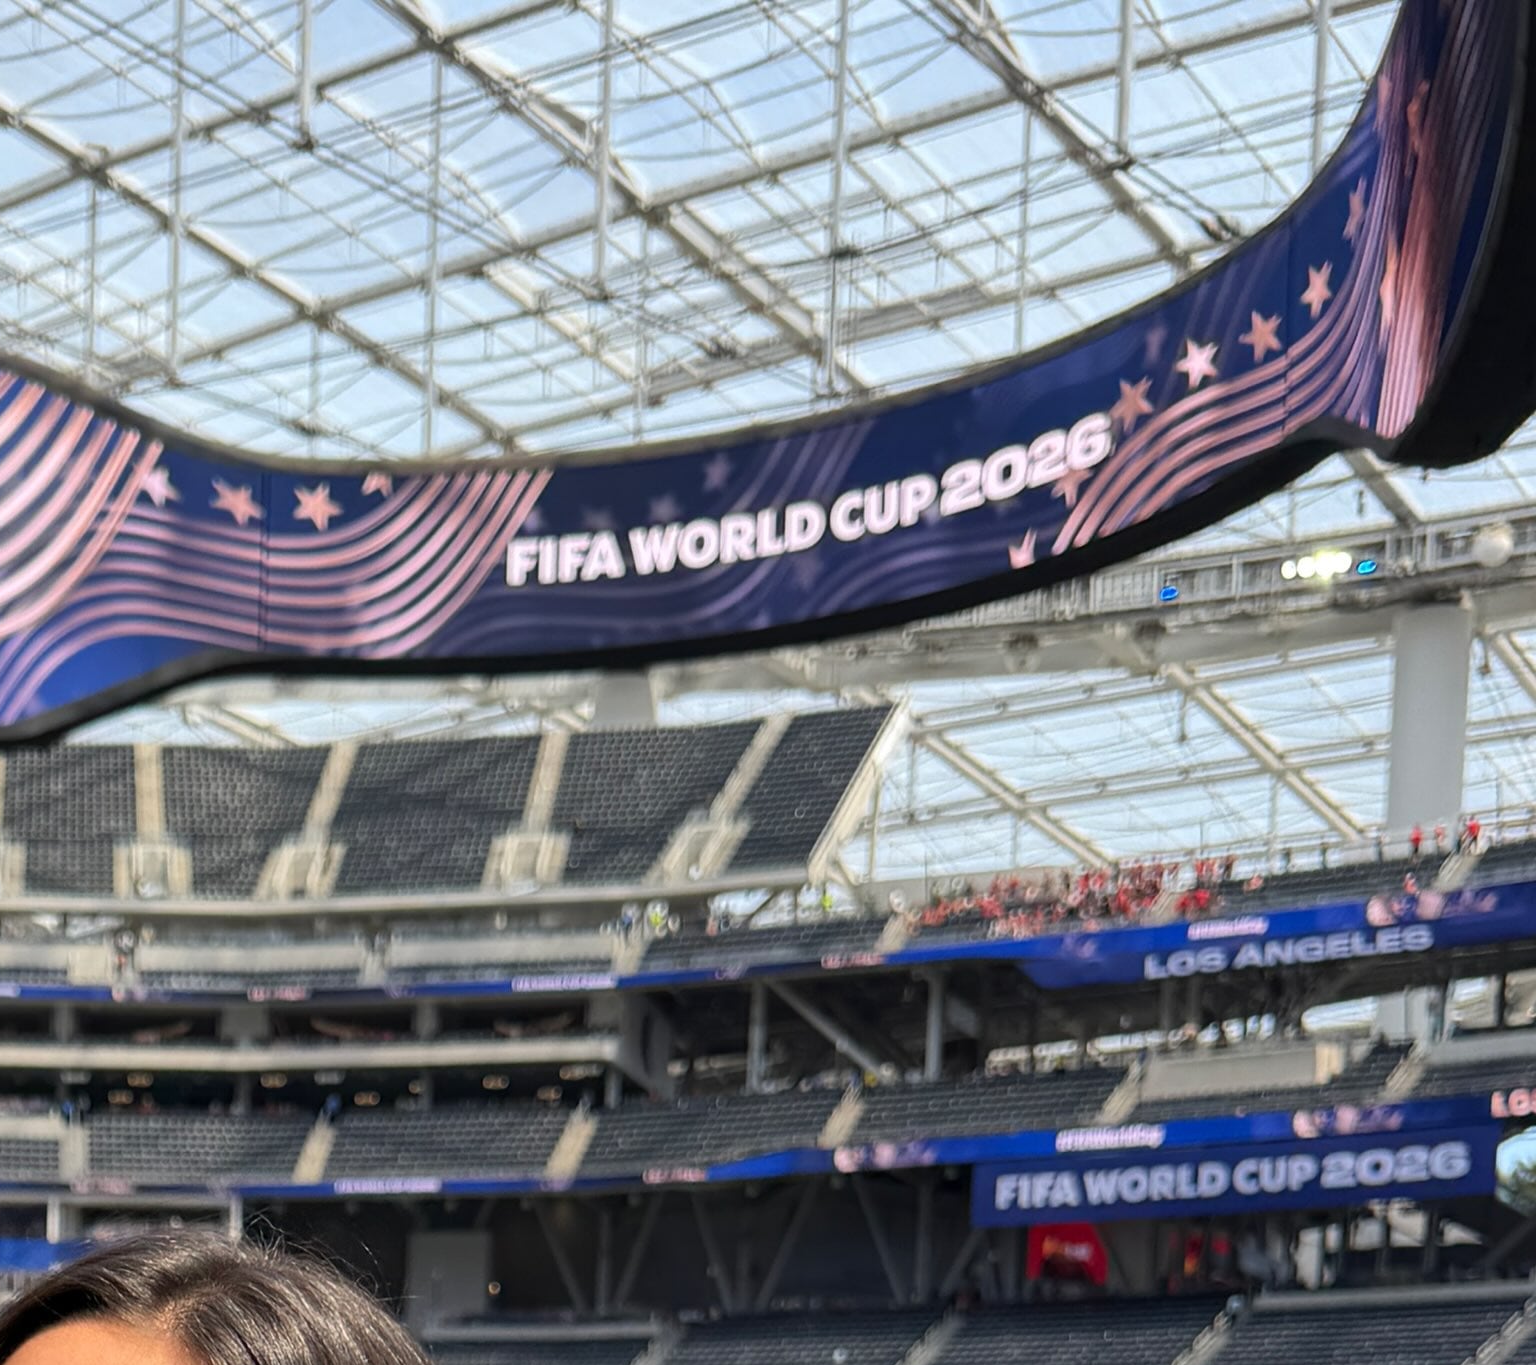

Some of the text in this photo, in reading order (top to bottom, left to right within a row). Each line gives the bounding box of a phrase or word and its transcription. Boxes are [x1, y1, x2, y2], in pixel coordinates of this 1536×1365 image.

[505, 412, 1113, 587] FIFA WORLD CUP 2026
[1144, 923, 1434, 980] LOS ANGELES
[994, 1142, 1471, 1210] FIFA WORLD CUP 2026
